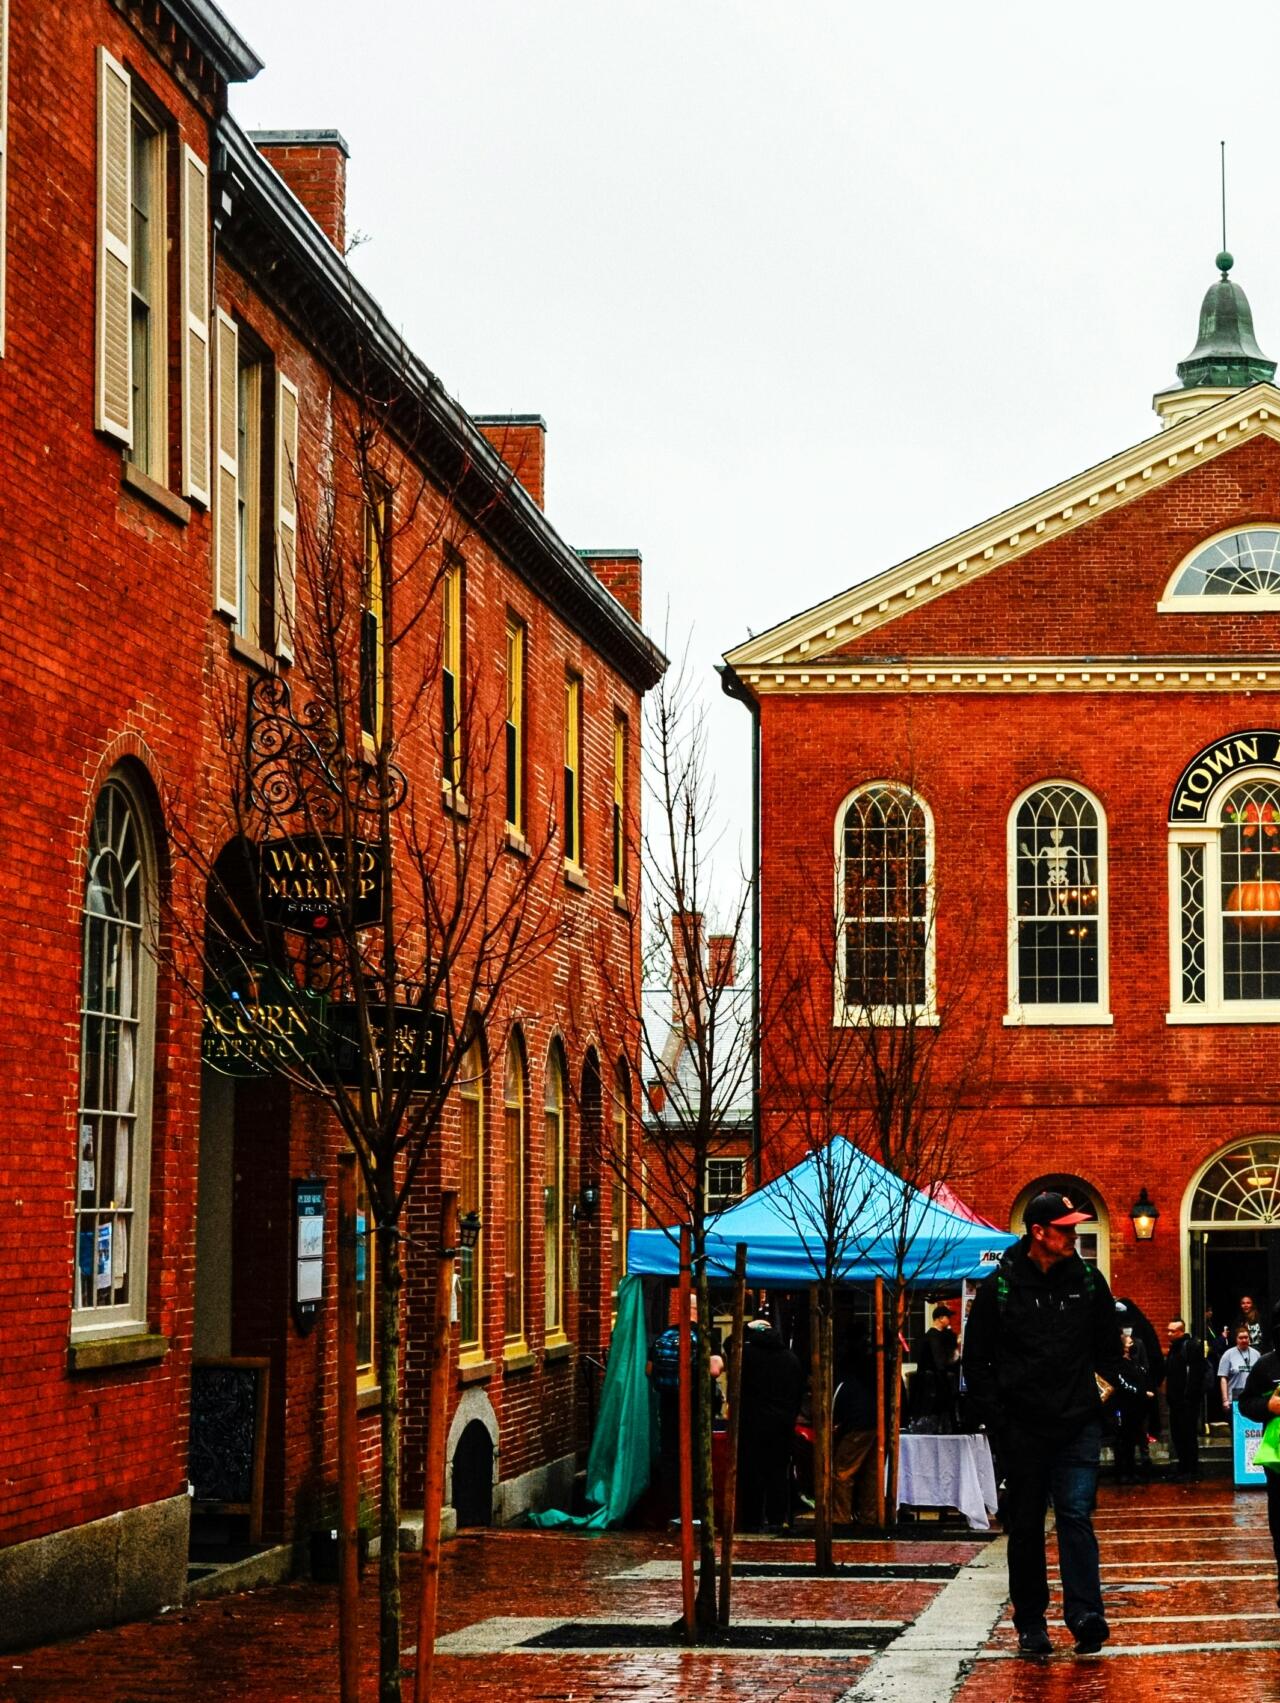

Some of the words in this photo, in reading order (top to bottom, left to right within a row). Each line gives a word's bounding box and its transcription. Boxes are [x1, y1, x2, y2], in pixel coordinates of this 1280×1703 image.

[1177, 737, 1259, 812] TOWN
[270, 850, 375, 872] WICKD
[267, 878, 376, 899] MAKEP
[202, 1004, 308, 1036] ACORN
[1263, 1215, 1273, 1224] 32
[1244, 1429, 1263, 1438] SCA
